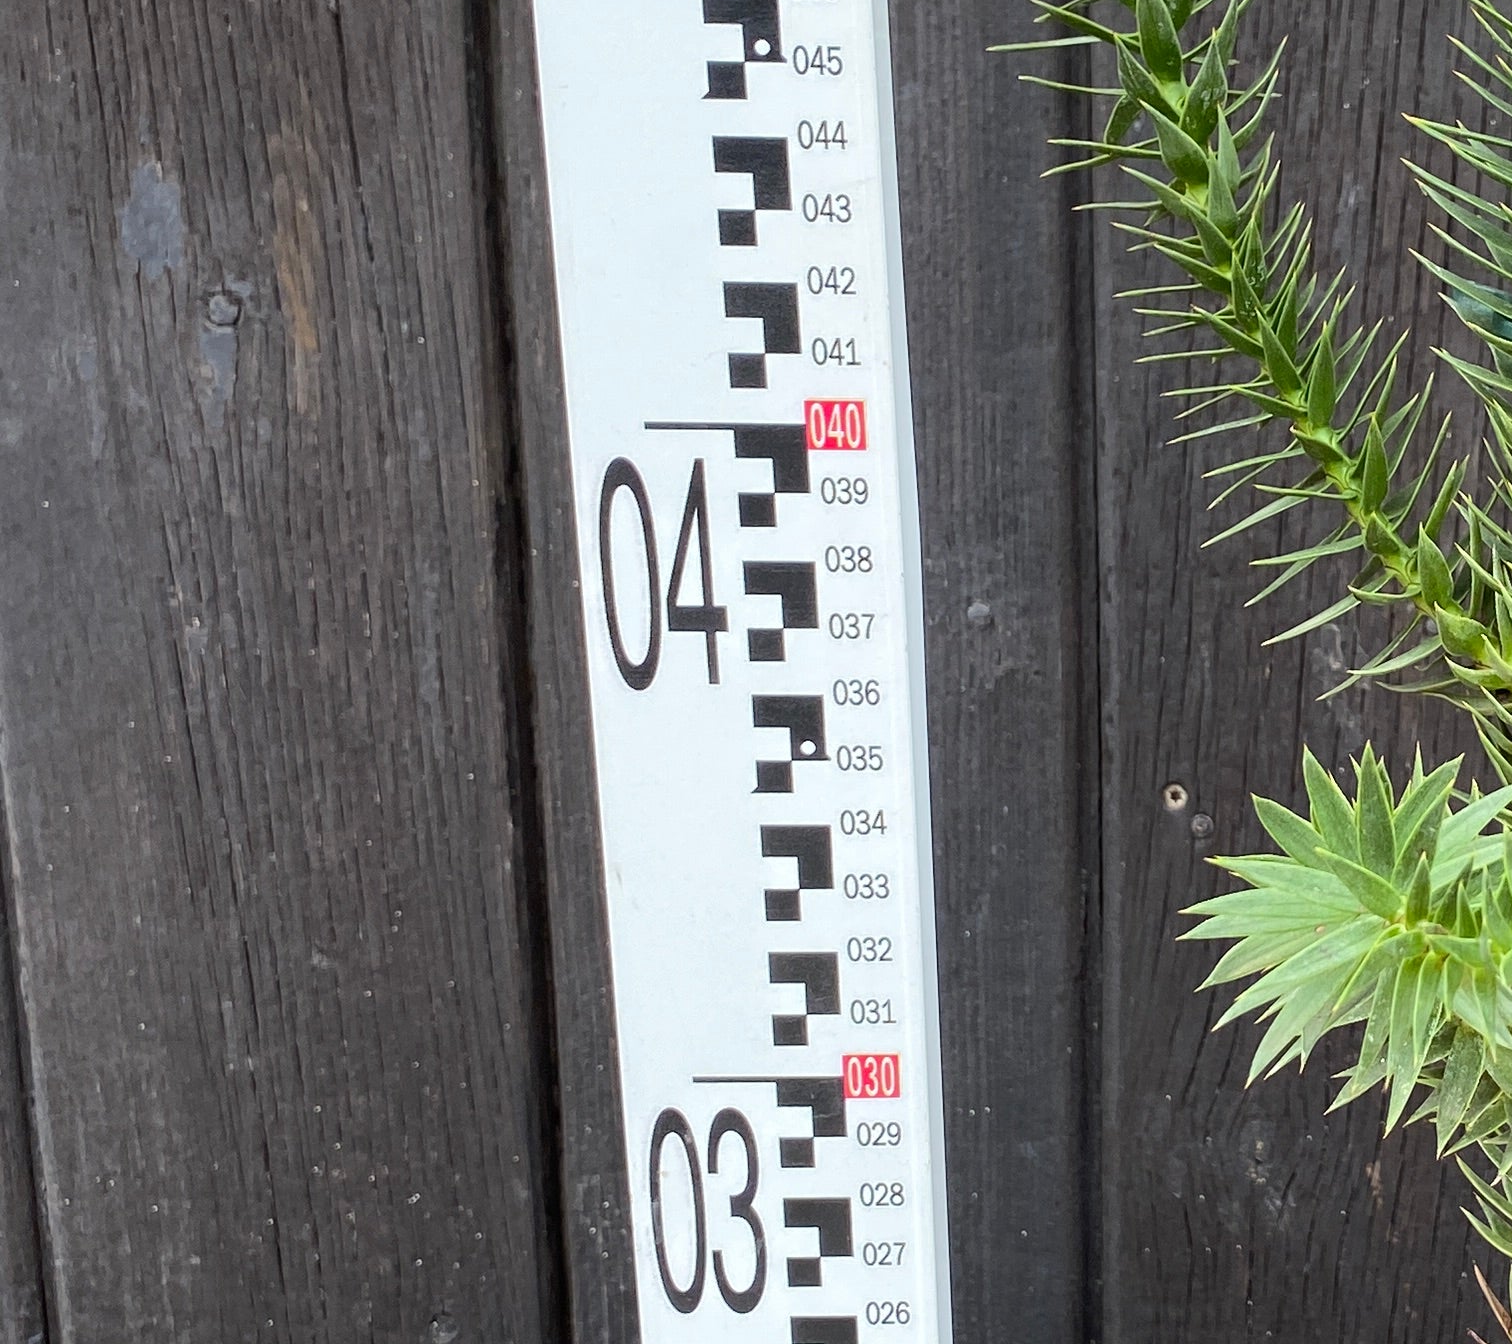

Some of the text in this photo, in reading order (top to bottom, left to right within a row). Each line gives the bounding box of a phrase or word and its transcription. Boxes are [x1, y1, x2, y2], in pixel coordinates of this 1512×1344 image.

[792, 45, 843, 76] 045
[797, 119, 848, 150] 044
[802, 193, 852, 223] 043
[807, 266, 857, 295] 042
[811, 337, 861, 366] 041
[809, 402, 862, 449] 040
[820, 477, 869, 505] 039
[824, 545, 873, 573] 038
[600, 456, 728, 691] 04
[828, 613, 875, 640] 037
[832, 679, 880, 706] 036
[836, 745, 883, 772] 035
[840, 809, 888, 836] 034
[843, 873, 890, 900] 033
[846, 936, 893, 962] 032
[850, 999, 897, 1025] 031
[847, 1056, 896, 1097] 030
[856, 1122, 902, 1147] 029
[859, 1182, 905, 1207] 028
[650, 1107, 767, 1313] 03
[862, 1242, 906, 1266] 027
[865, 1301, 910, 1326] 026
